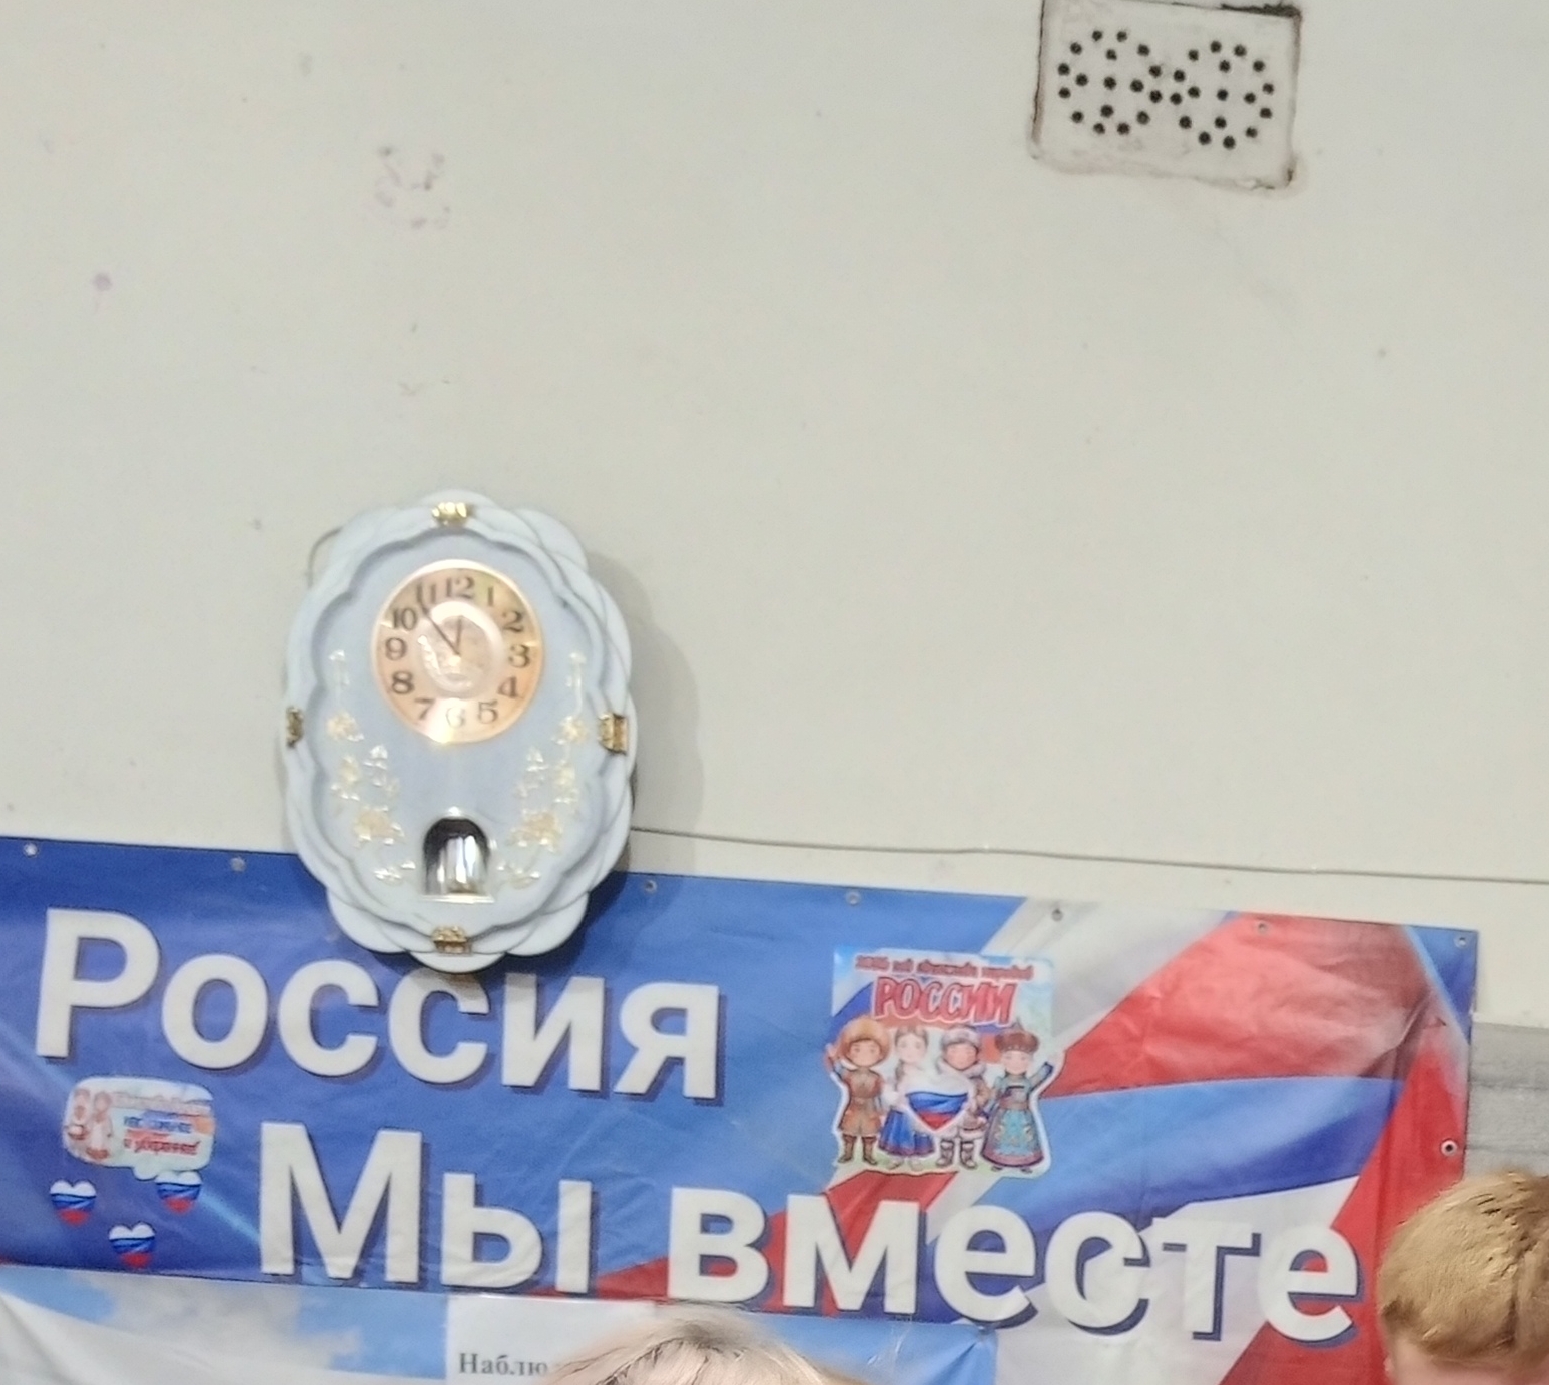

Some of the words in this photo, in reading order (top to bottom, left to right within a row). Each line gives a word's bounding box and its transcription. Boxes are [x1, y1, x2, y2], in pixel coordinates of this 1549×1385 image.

[446, 576, 474, 599] 12
[486, 586, 494, 607] 1
[393, 607, 417, 630] 10
[502, 611, 523, 632] 2
[385, 637, 407, 660] 9
[508, 645, 530, 667] 3
[391, 671, 414, 694] 8
[497, 677, 518, 698] 4
[414, 697, 434, 720] 7
[446, 707, 464, 728] 6
[478, 700, 498, 723] 5
[36, 908, 719, 1099] Россия
[875, 977, 1016, 1024] РОССИИ
[260, 1122, 592, 1295] Мы
[666, 1186, 1360, 1344] вместе
